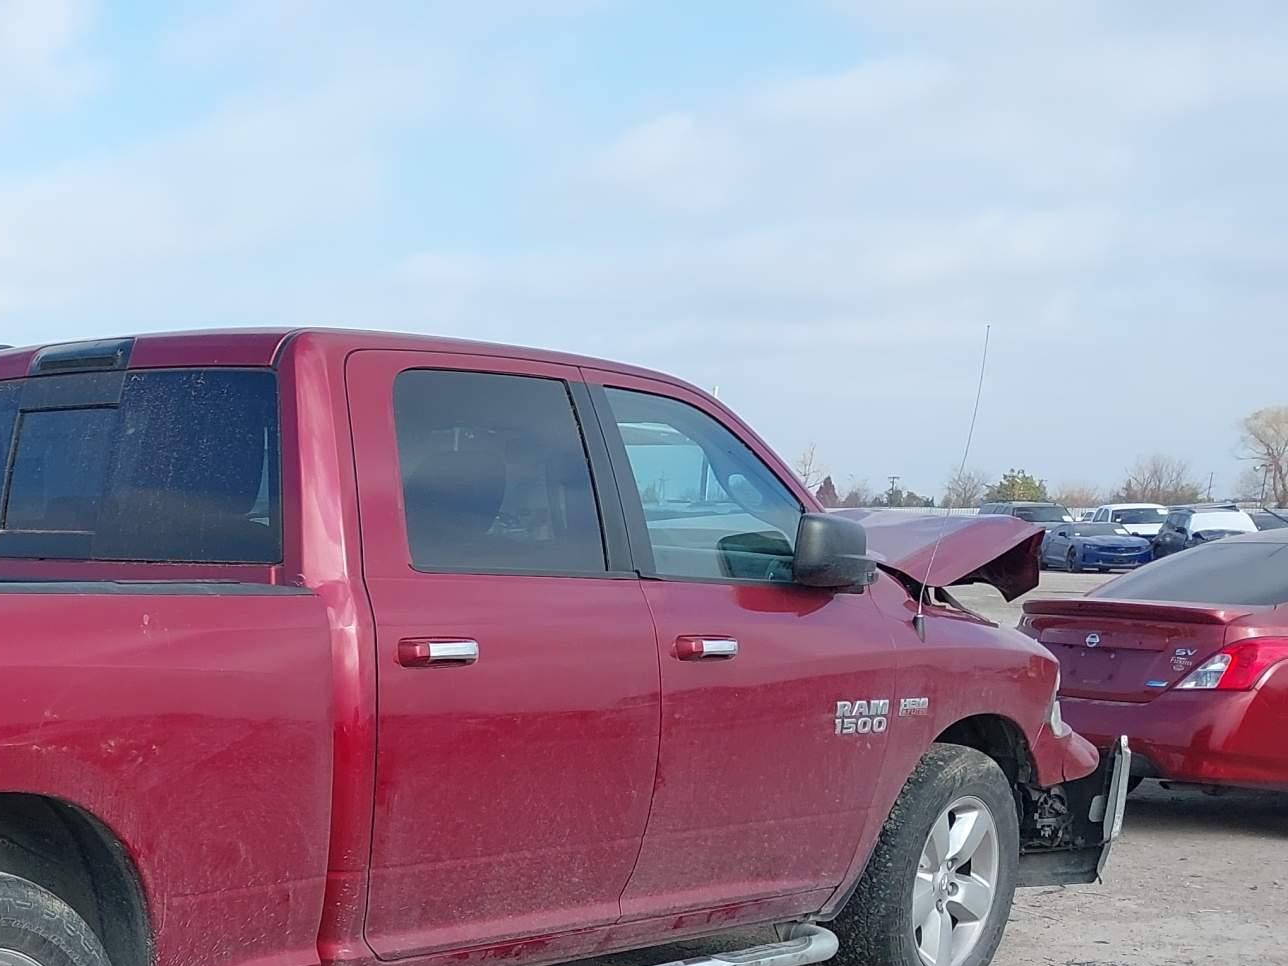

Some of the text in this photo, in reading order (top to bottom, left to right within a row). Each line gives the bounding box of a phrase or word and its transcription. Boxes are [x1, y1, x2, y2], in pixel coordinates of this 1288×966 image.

[1175, 648, 1198, 656] SV
[836, 699, 890, 717] RAM
[834, 716, 887, 735] 1500
